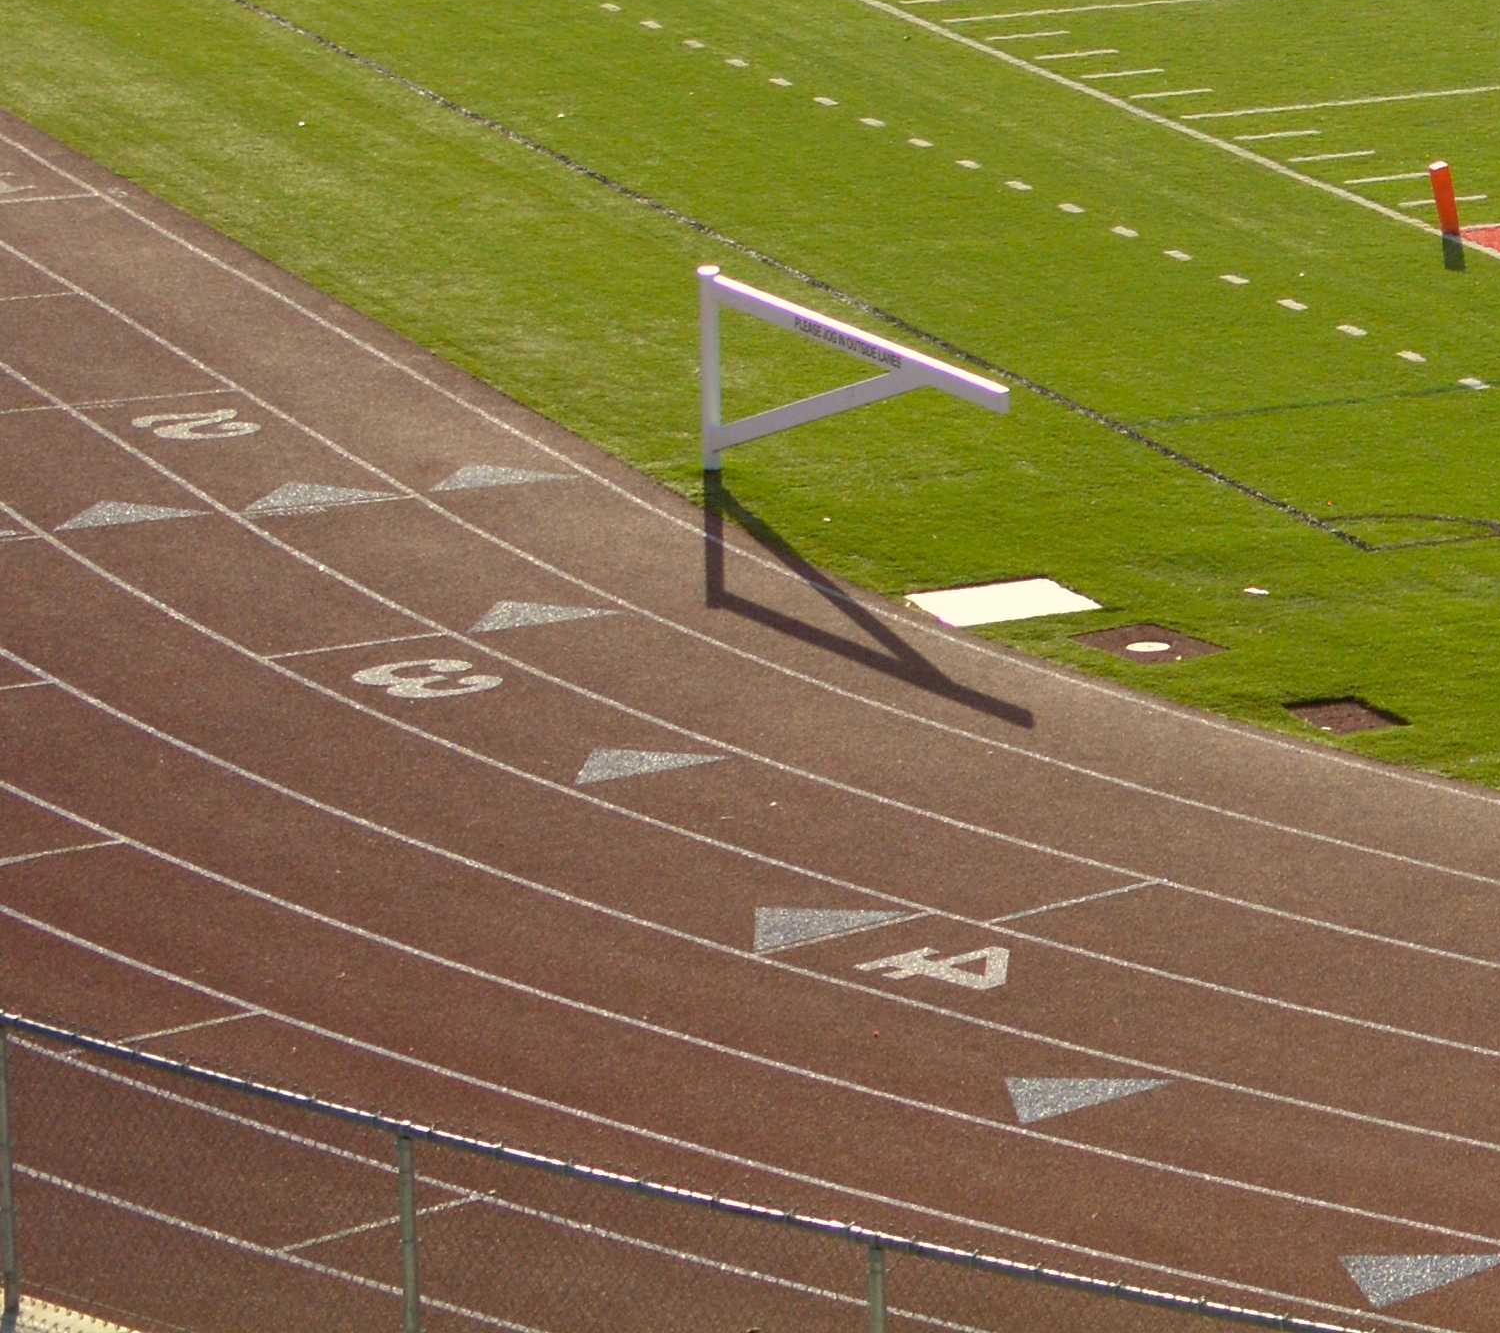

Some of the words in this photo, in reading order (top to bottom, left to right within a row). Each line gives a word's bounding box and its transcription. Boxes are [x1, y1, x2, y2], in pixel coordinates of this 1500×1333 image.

[132, 407, 262, 441] 2
[352, 658, 504, 700] 3
[856, 944, 1010, 990] 4
